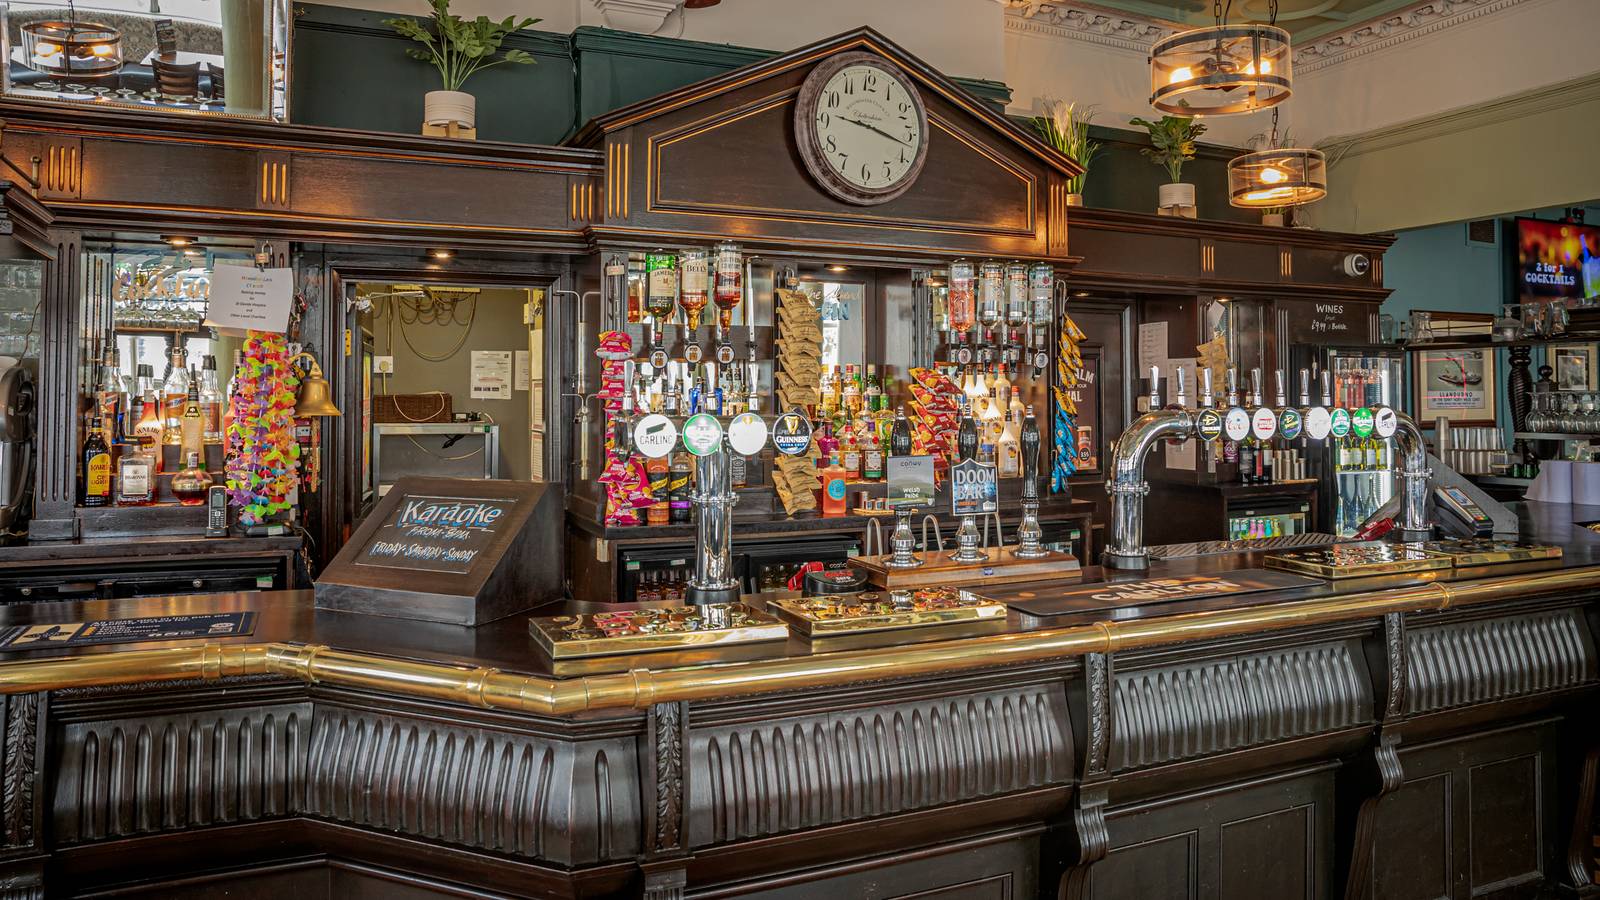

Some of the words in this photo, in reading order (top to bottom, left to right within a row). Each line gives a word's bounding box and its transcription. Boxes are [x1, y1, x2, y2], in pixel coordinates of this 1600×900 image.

[844, 77, 853, 95] 11
[863, 74, 876, 93] 12
[886, 83, 891, 101] 1
[828, 90, 839, 108] 10
[898, 102, 907, 120] 2
[820, 112, 829, 129] 9
[904, 125, 912, 142] 3
[826, 134, 836, 153] 8
[838, 153, 848, 170] 7
[881, 161, 891, 178] 5
[861, 163, 870, 181] 6
[1543, 262, 1557, 273] for
[1525, 272, 1576, 285] COCKTAILS
[1315, 303, 1344, 314] WINES
[639, 434, 673, 445] CARLING
[776, 435, 808, 444] GUINNESS
[956, 469, 995, 485] DOOM
[957, 484, 984, 499] BAR
[400, 500, 503, 525] Karaoke
[372, 541, 404, 557] FRIDAY
[446, 547, 479, 561] SUNDAY
[1091, 580, 1241, 600] CARLTON
[1106, 579, 1179, 590] THE
